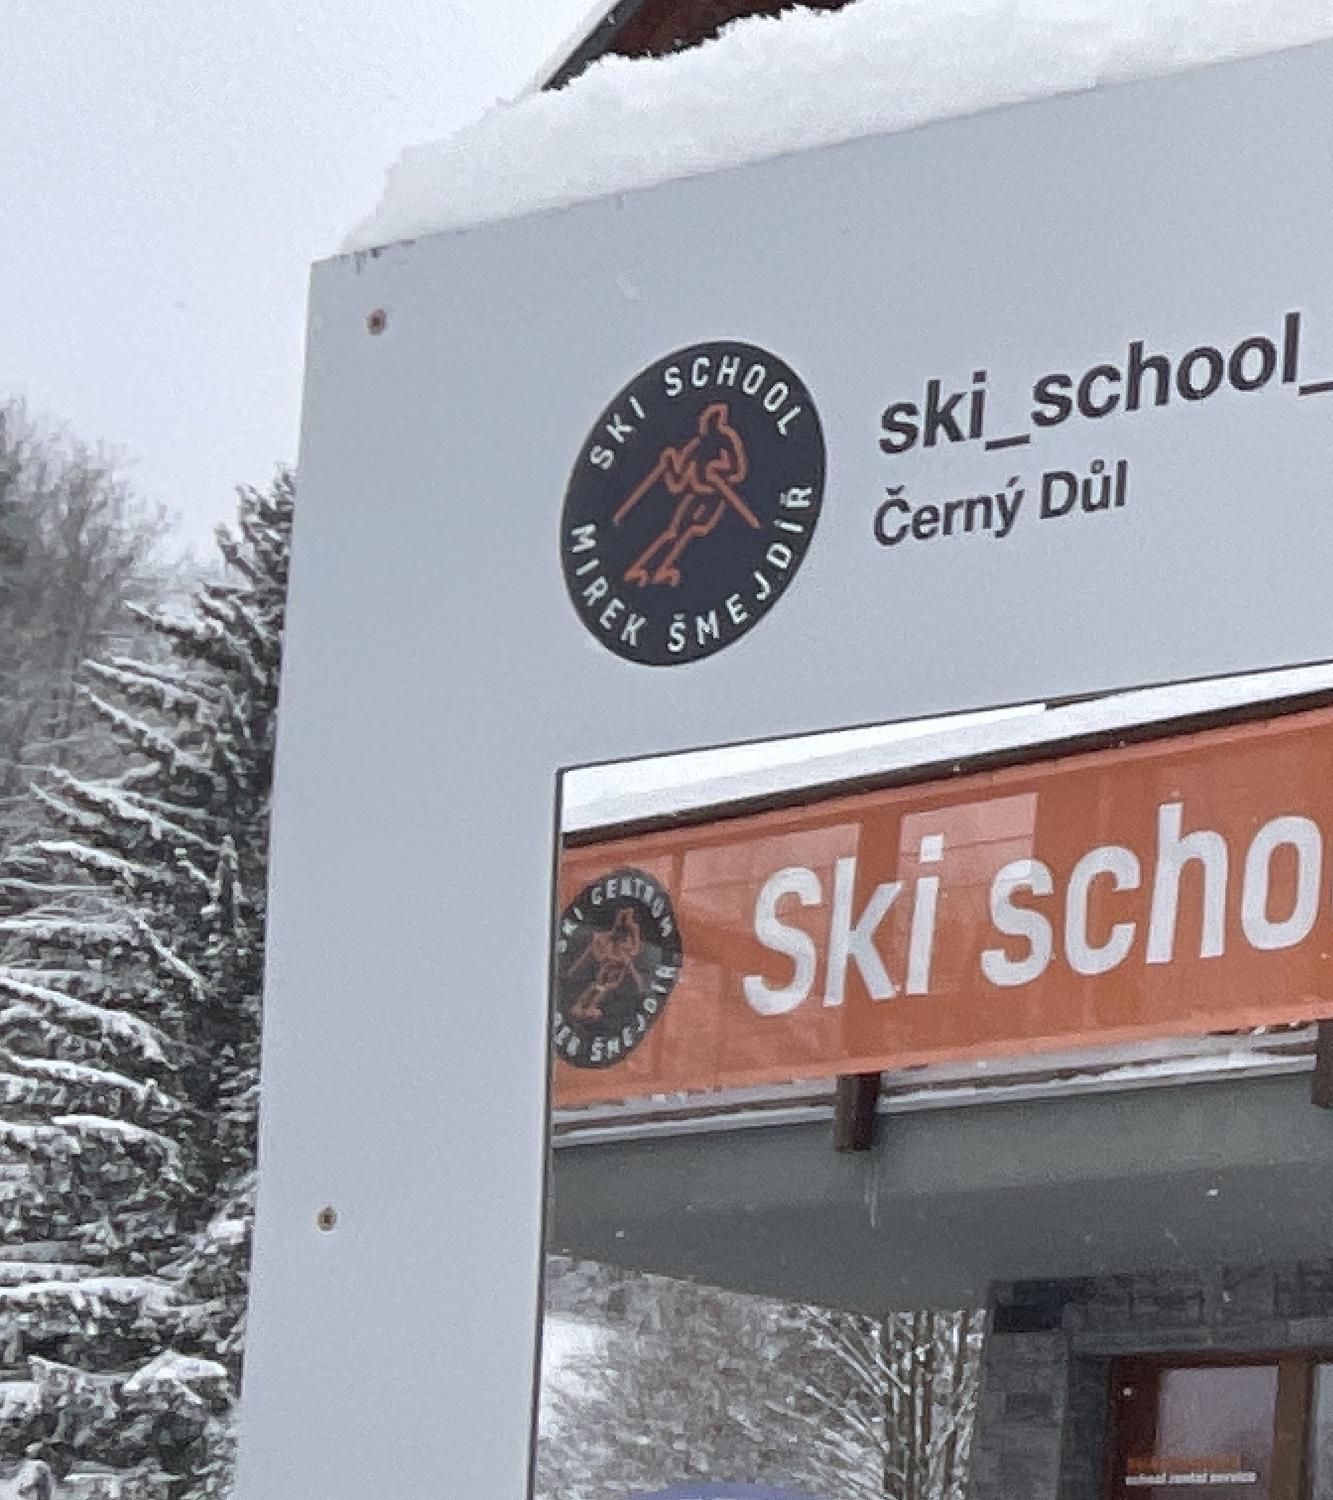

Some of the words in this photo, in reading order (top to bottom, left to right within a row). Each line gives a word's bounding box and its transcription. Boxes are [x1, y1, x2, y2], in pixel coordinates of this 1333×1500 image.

[589, 396, 646, 470] SKI
[663, 356, 802, 437] SCHOOL
[873, 477, 1025, 547] Černý
[1040, 461, 1128, 521] Důl
[570, 522, 647, 647] MIREK
[743, 832, 945, 1017] Ski
